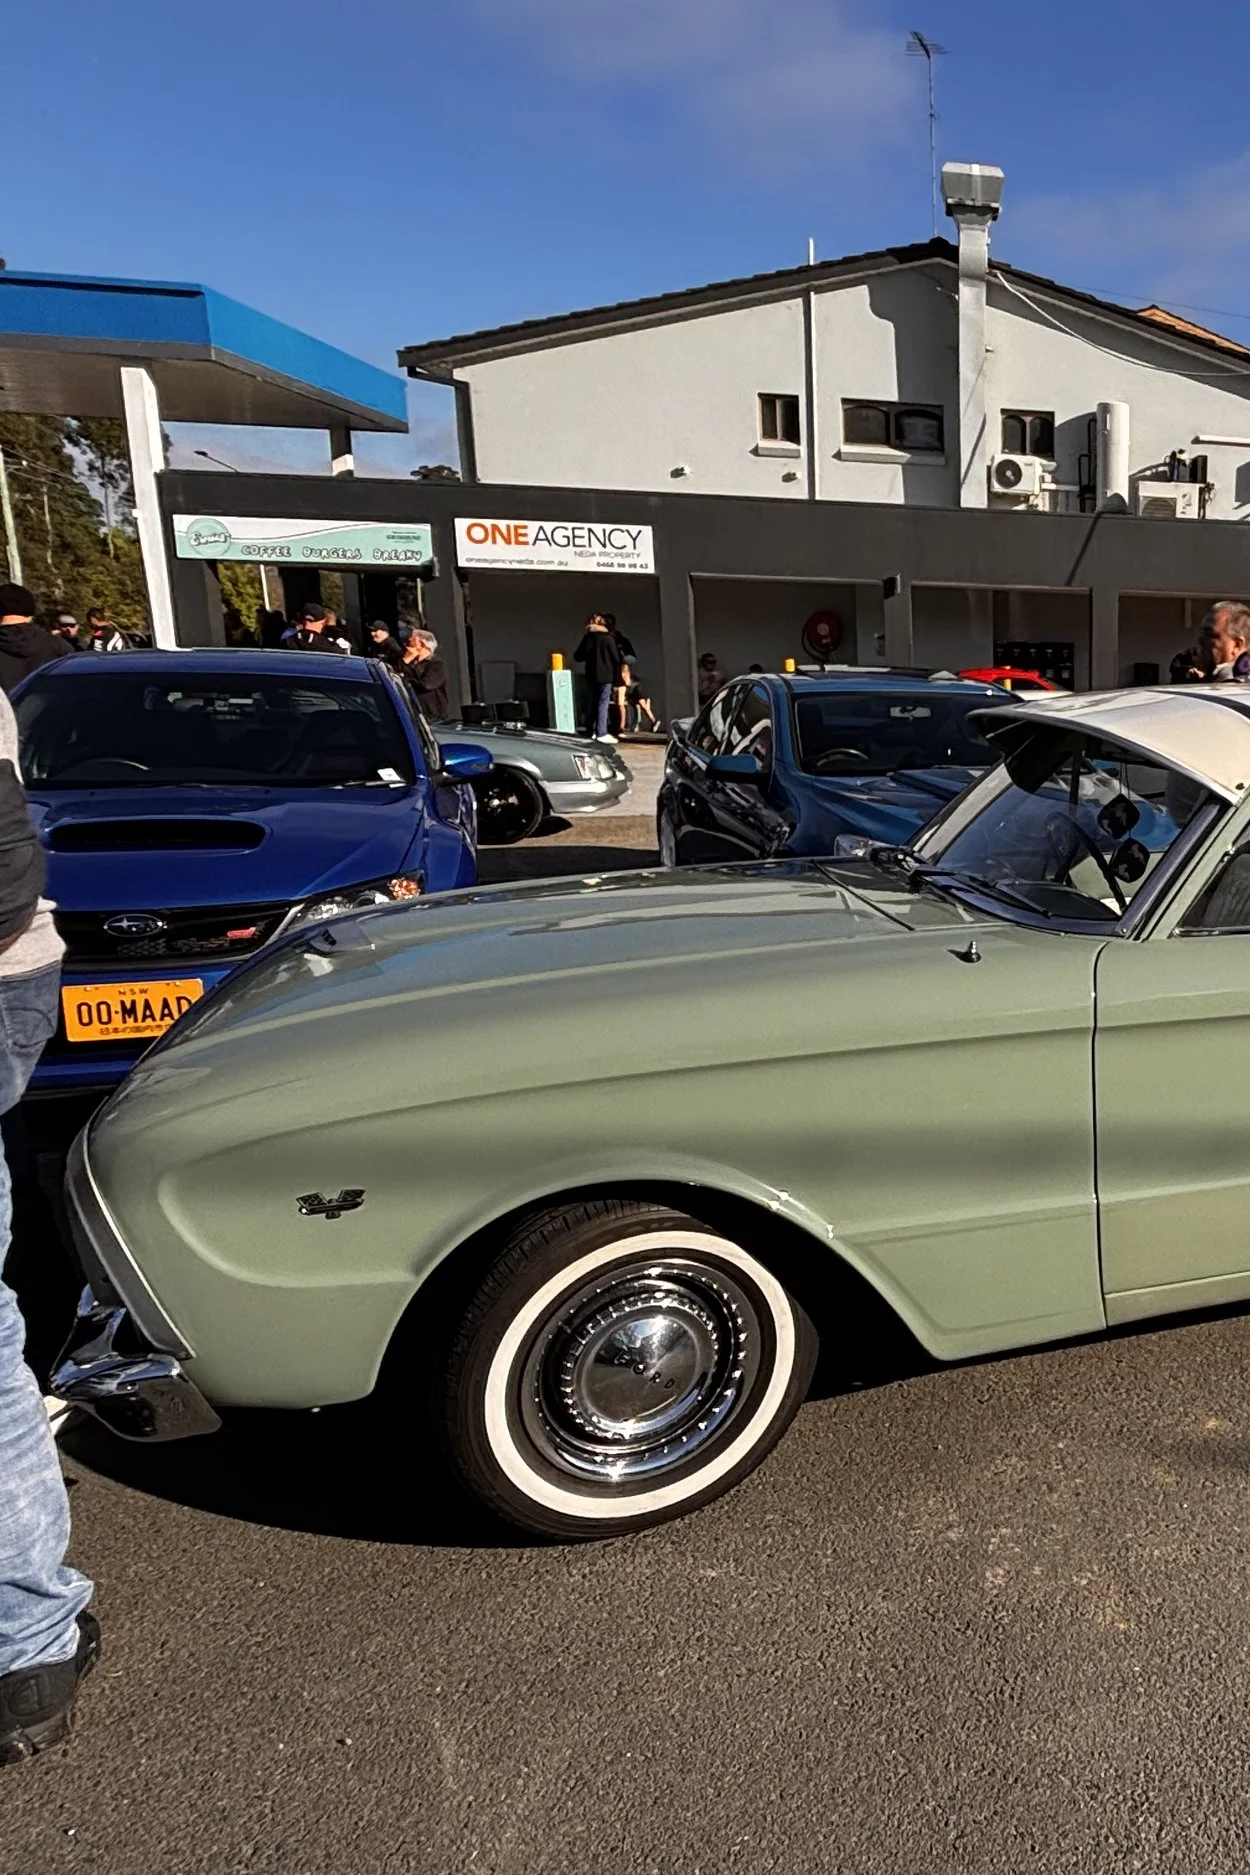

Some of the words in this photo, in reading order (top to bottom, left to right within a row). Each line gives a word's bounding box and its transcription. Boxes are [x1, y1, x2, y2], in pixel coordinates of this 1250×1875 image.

[466, 522, 530, 546] ONE
[532, 525, 643, 551] AGENCY
[241, 545, 292, 558] COFFEE
[302, 546, 362, 560] BURGERS
[599, 550, 641, 560] PROPERTY
[118, 987, 149, 996] NSW
[614, 1349, 675, 1389] FORD
